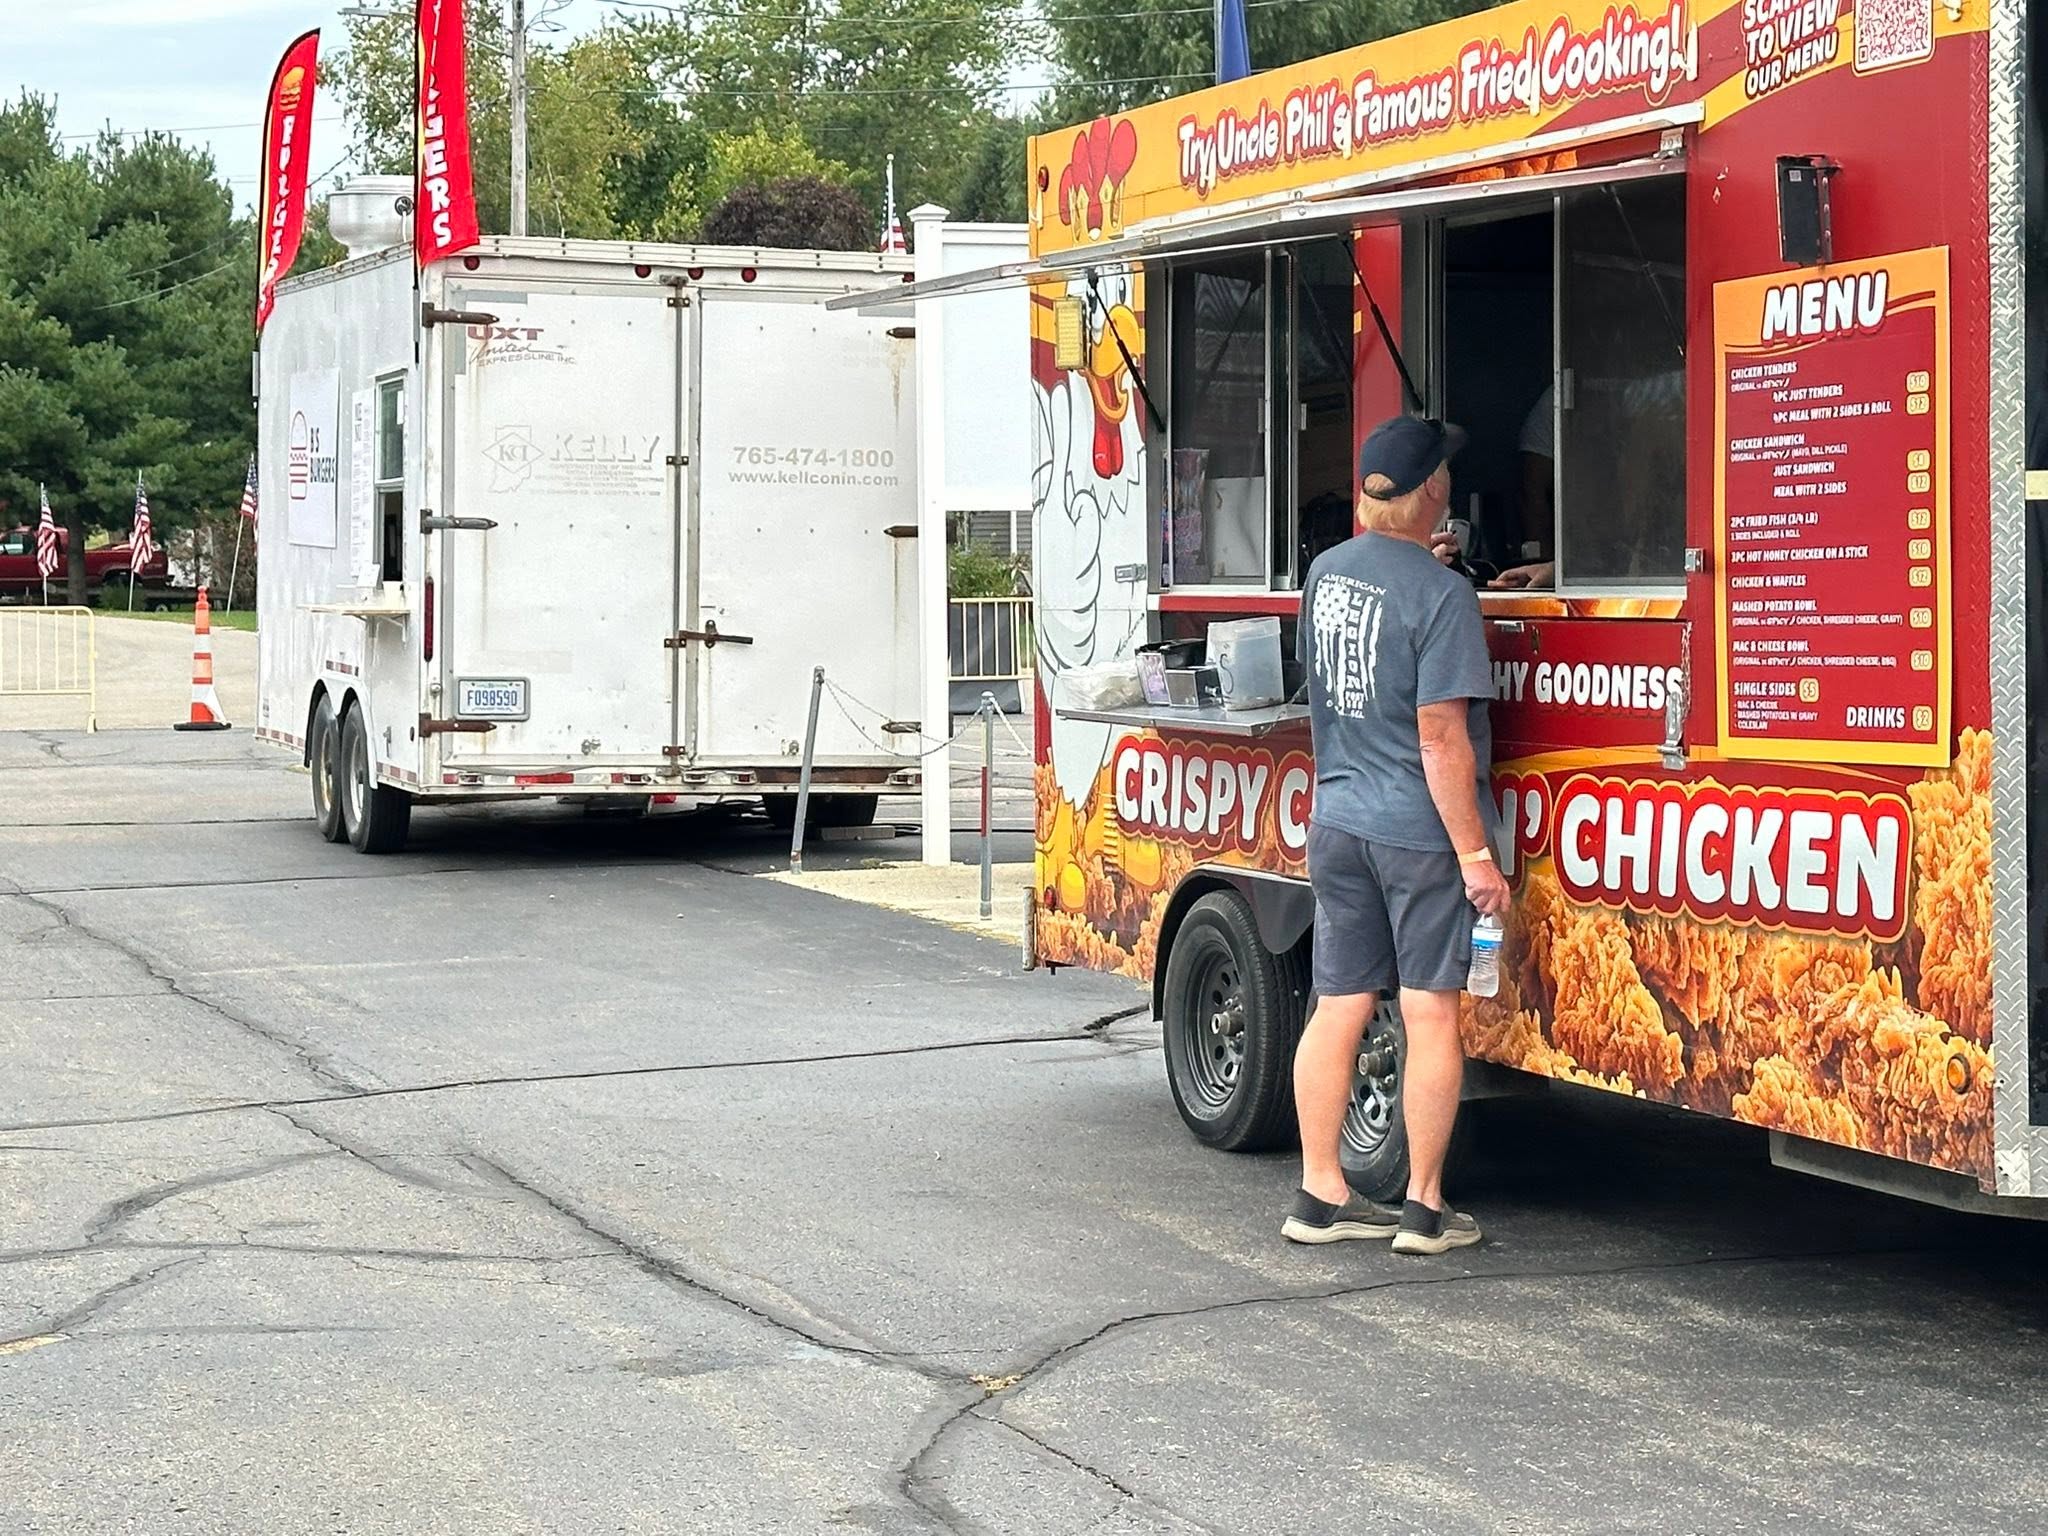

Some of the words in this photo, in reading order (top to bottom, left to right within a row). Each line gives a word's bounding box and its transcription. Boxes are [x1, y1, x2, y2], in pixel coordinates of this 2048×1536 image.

[1746, 24, 1775, 64] TO
[1779, 0, 1838, 49] VIEW
[1746, 58, 1783, 96] OUR
[1784, 29, 1838, 79] MENU
[1179, 120, 1213, 188] Try
[1217, 106, 1279, 171] Uncle
[1285, 86, 1348, 155] Phil's
[1354, 78, 1452, 140] Famous
[1461, 34, 1534, 115] Fried
[1541, 3, 1681, 94] Cooking!
[1761, 271, 1888, 341] MENU
[468, 325, 545, 341] UXT
[1731, 365, 1763, 380] CHICKEN
[1763, 361, 1797, 376] TENDERS
[1789, 388, 1807, 402] JUST
[1808, 384, 1843, 399] TENDERS
[1789, 409, 1809, 422] MEAL
[1810, 407, 1832, 420] WITH
[1832, 406, 1839, 418] 2
[1839, 403, 1862, 417] SIDES
[1871, 401, 1892, 414] ROLL
[1731, 437, 1763, 450] CHICKEN
[1764, 433, 1805, 448] SANDWICH
[733, 446, 894, 468] 765-474-1800
[1773, 464, 1792, 477] JUST
[1793, 461, 1835, 475] SANDWICH
[728, 470, 898, 487] www.kellconin.com
[1773, 485, 1794, 498] MEAL
[1795, 483, 1816, 496] WITH
[1817, 482, 1824, 494] 2
[1824, 481, 1847, 494] SIDES
[1746, 515, 1768, 527] FRIED
[1768, 514, 1787, 525] FISH
[1746, 550, 1763, 562] HOT
[1763, 549, 1789, 562] HONEY
[1790, 547, 1824, 560] CHICKEN
[1825, 547, 1837, 559] ON
[1838, 547, 1844, 559] A
[1845, 545, 1868, 558] STICK
[1322, 573, 1387, 596] AMERICAN
[1731, 575, 1764, 588] CHICKEN
[1772, 574, 1806, 587] WAFFLES
[1732, 600, 1763, 612] MASHED
[1764, 600, 1793, 612] POTATO
[1794, 599, 1817, 611] BOWL
[1732, 640, 1749, 652] MAC
[1757, 640, 1785, 652] CHEESE
[1786, 640, 1809, 652] BOWL
[1534, 661, 1685, 711] GOODNESS
[1734, 682, 1767, 696] SINGLE
[1768, 682, 1796, 696] SIDES
[1846, 706, 1906, 728] DRINKS
[1115, 747, 1268, 841] CRISPY
[1560, 793, 1900, 921] CHICKEN
